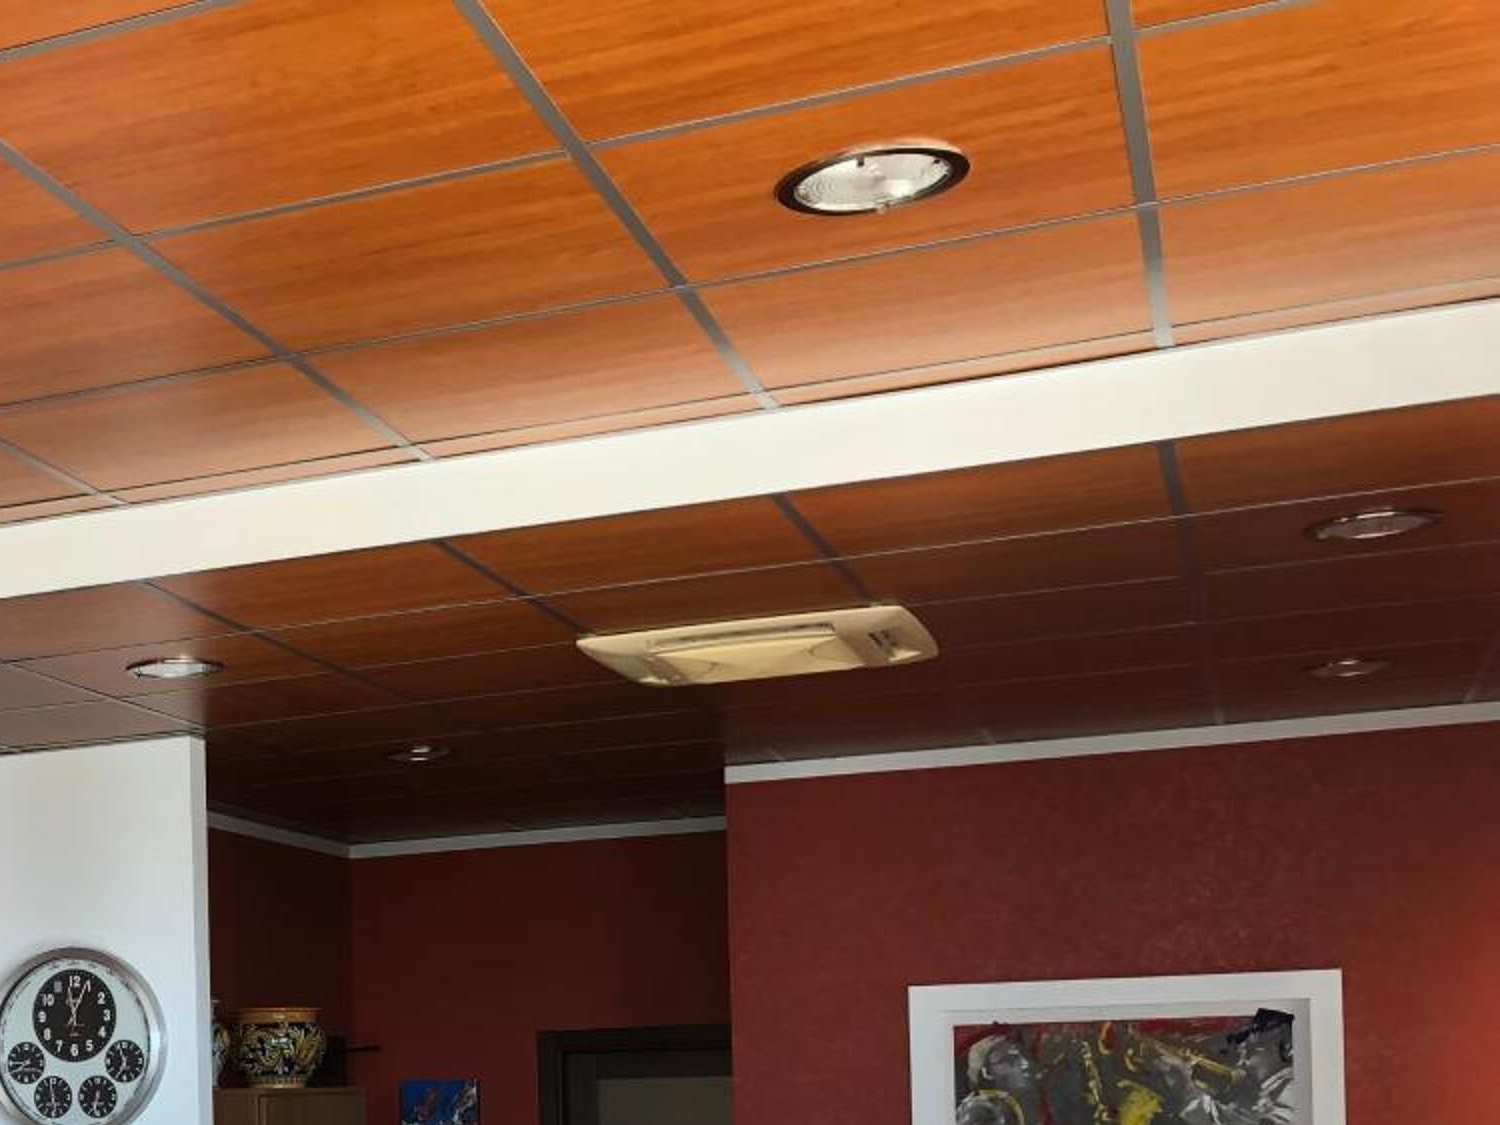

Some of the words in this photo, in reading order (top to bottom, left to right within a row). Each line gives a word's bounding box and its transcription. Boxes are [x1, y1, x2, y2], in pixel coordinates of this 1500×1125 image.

[69, 975, 81, 987] 12
[42, 993, 55, 1006] 10
[97, 991, 106, 1005] 2
[38, 1011, 47, 1023] 9
[103, 1009, 111, 1021] 3
[43, 1028, 51, 1041] 8
[97, 1026, 106, 1038] 4
[55, 1040, 63, 1052] 7
[70, 1043, 79, 1057] 6
[85, 1039, 94, 1052] 5
